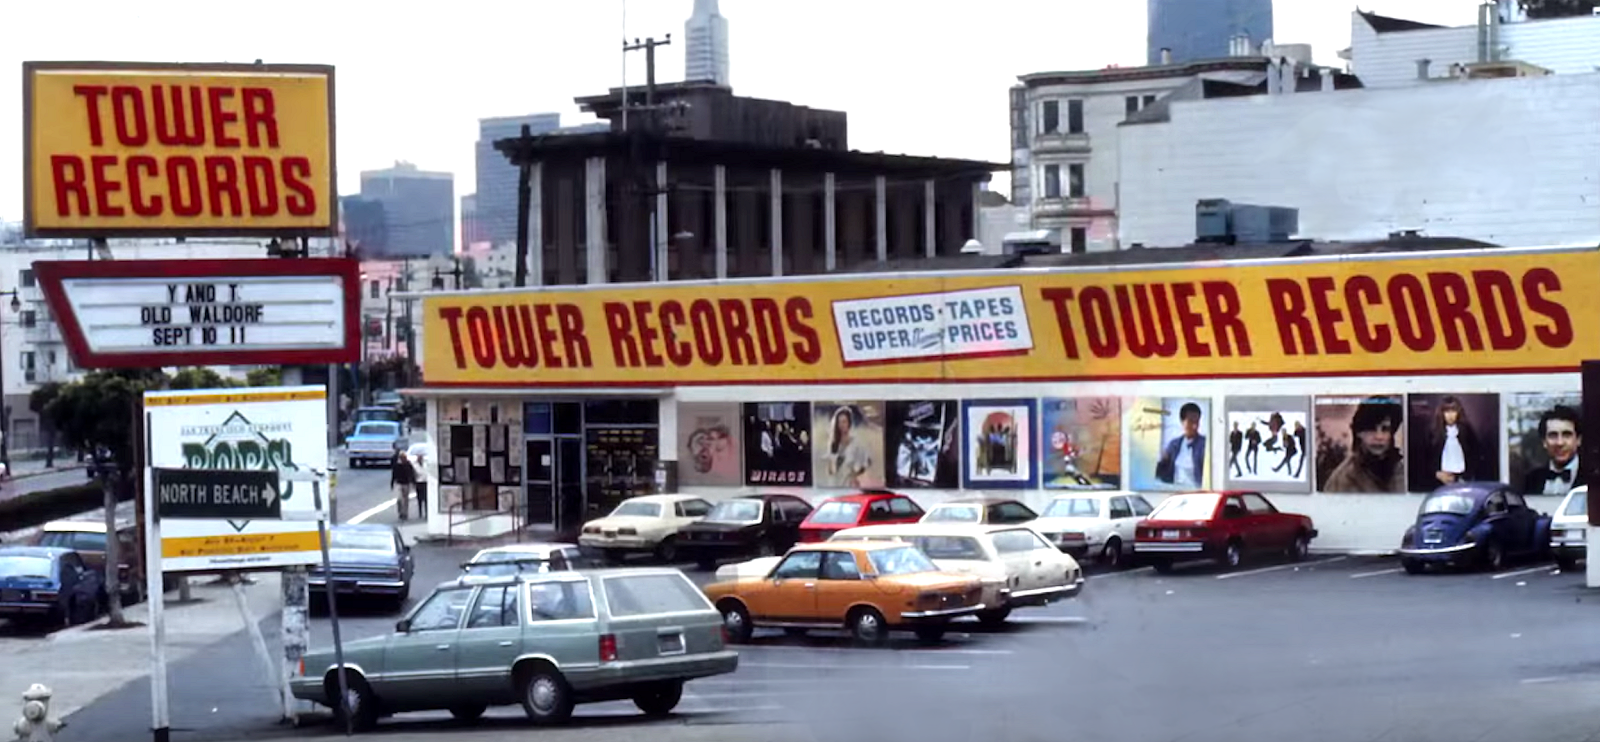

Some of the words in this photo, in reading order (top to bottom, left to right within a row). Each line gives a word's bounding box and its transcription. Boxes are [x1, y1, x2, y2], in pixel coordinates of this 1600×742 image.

[74, 85, 279, 148] TOWER
[51, 155, 317, 217] RECORDS
[168, 284, 177, 302] Y
[186, 284, 215, 302] AND
[141, 306, 171, 324] OLD
[190, 305, 264, 323] WALDORF
[846, 304, 935, 328] RECORDS
[945, 297, 1014, 320] TAPES
[1041, 280, 1252, 359] TOWER
[1266, 267, 1574, 354] RECORDS
[153, 327, 191, 345] SEPT
[202, 327, 217, 344] 10
[231, 327, 245, 344] 11
[439, 303, 592, 368] TOWER
[605, 297, 822, 367] RECORDS
[852, 329, 911, 350] SUPER
[948, 320, 1018, 342] PRICES
[160, 484, 207, 504] NORTH
[213, 484, 259, 504] BEACH
